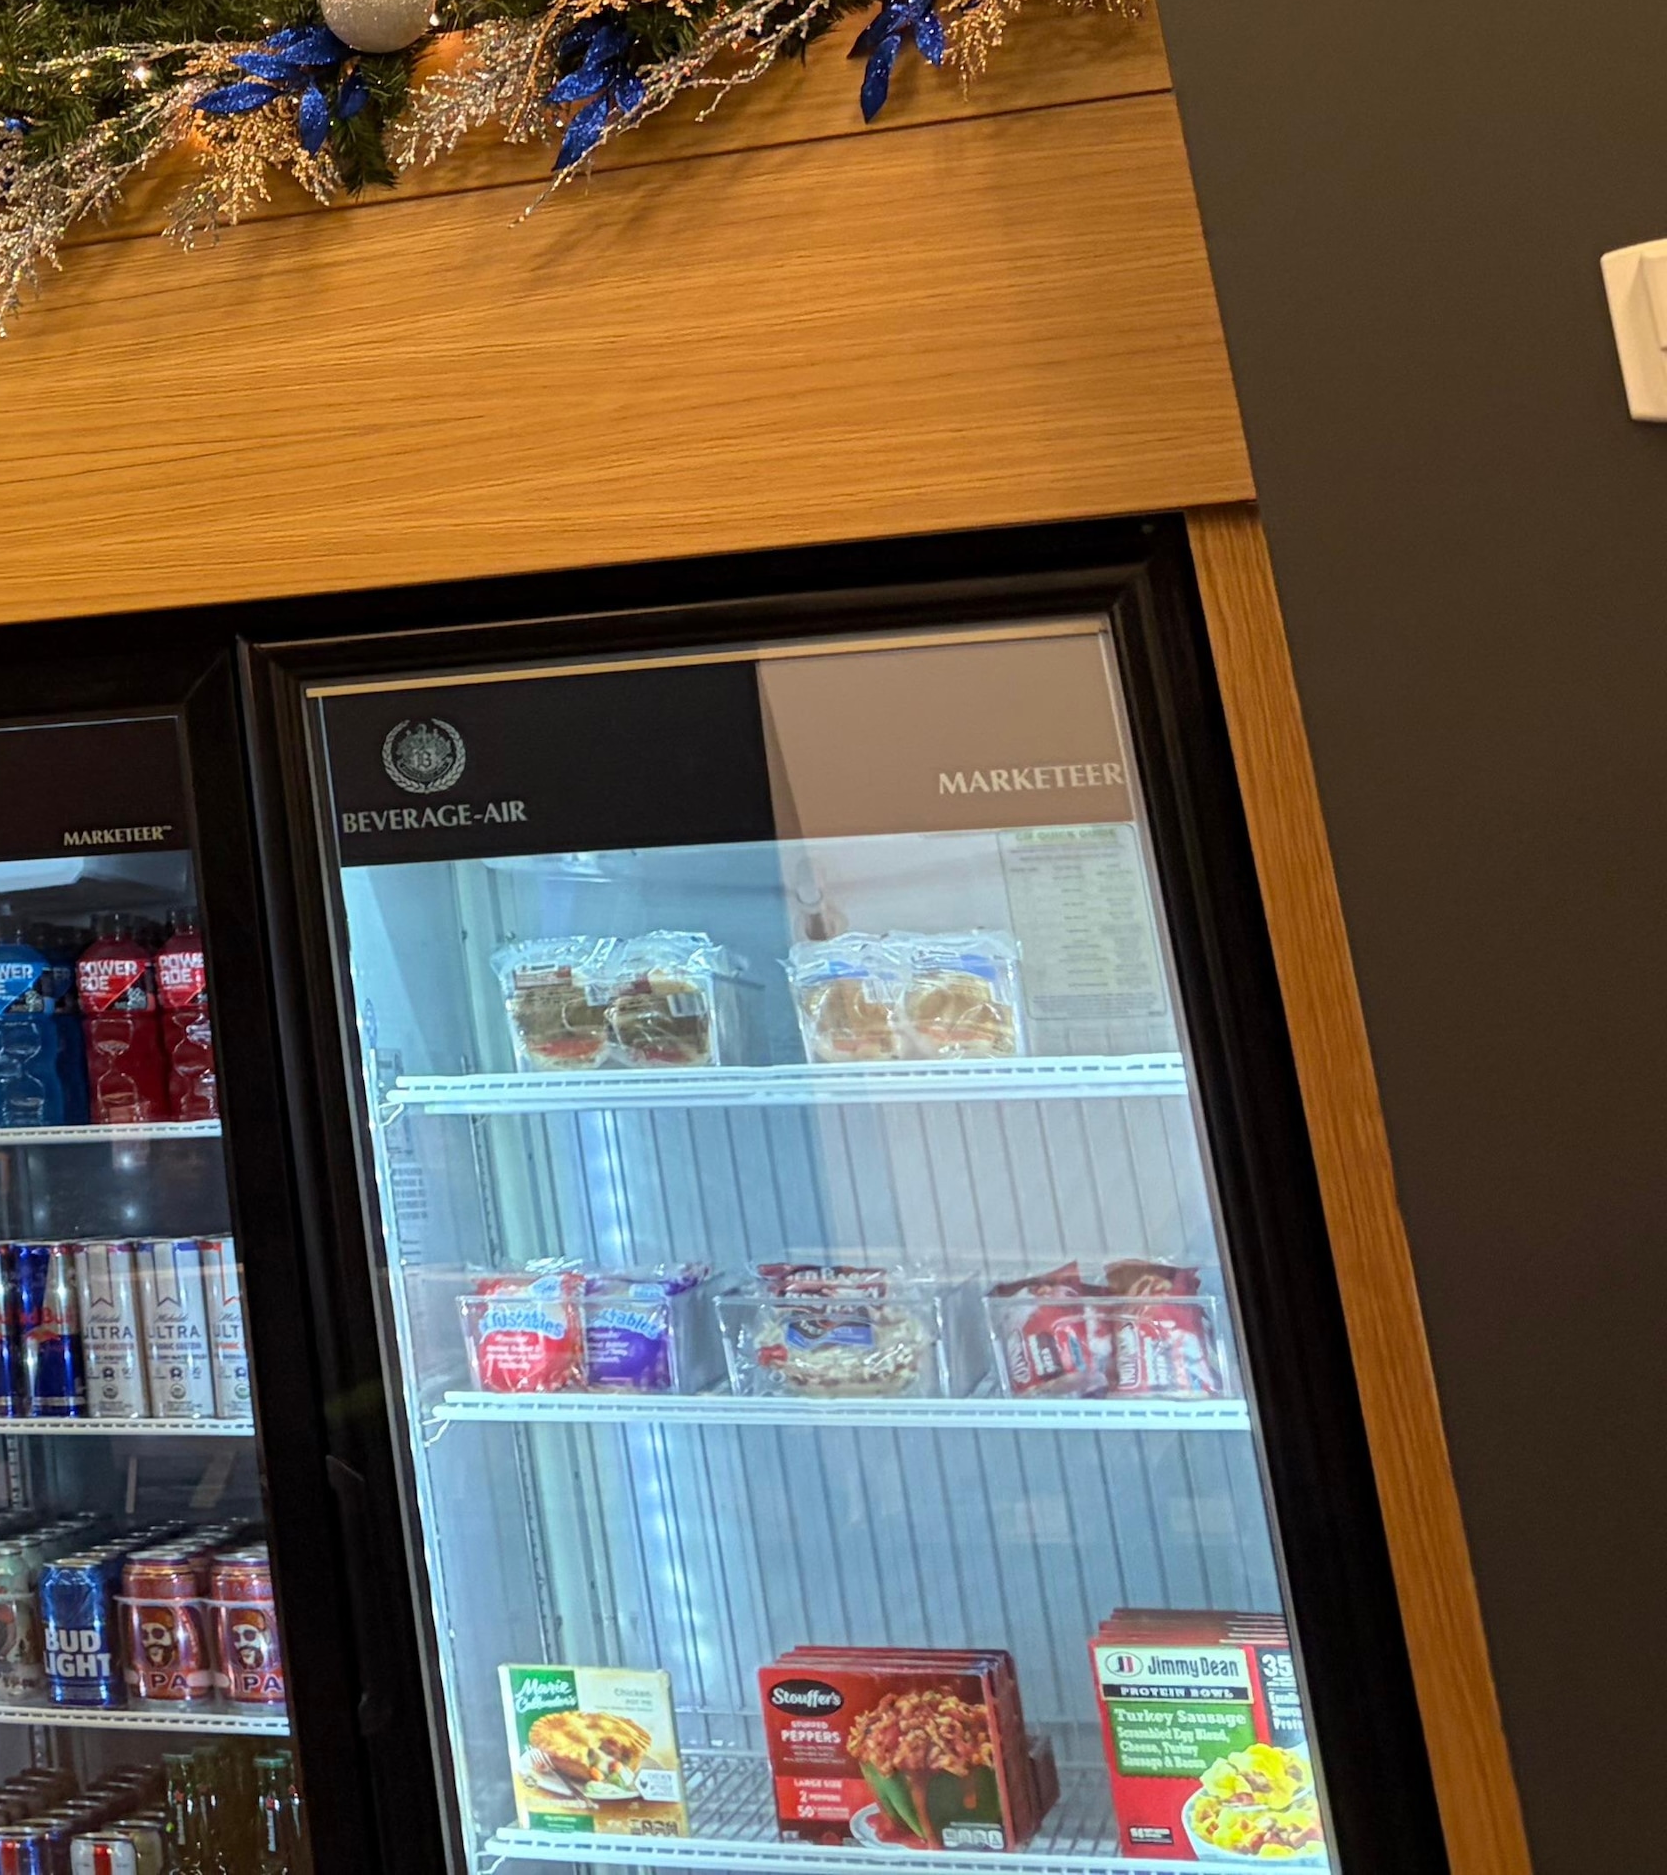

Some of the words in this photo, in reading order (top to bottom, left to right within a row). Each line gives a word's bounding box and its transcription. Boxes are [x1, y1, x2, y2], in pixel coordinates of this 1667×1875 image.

[938, 762, 1125, 796] MARKETEER
[342, 800, 528, 834] BEVERAGE-AIR
[78, 961, 137, 976] POWER
[45, 1628, 102, 1652] BUD
[44, 1651, 113, 1679] LIGHT
[1147, 1655, 1200, 1678] Jimmy
[1200, 1656, 1240, 1678] Dean
[515, 1677, 572, 1698] Marie
[771, 1687, 842, 1708] Stouffer's
[1120, 1686, 1186, 1698] PROTEIN
[1189, 1687, 1234, 1699] BOWL
[1113, 1707, 1174, 1726] Turkey
[1175, 1709, 1247, 1728] Sausage
[780, 1729, 842, 1744] PEPPERS
